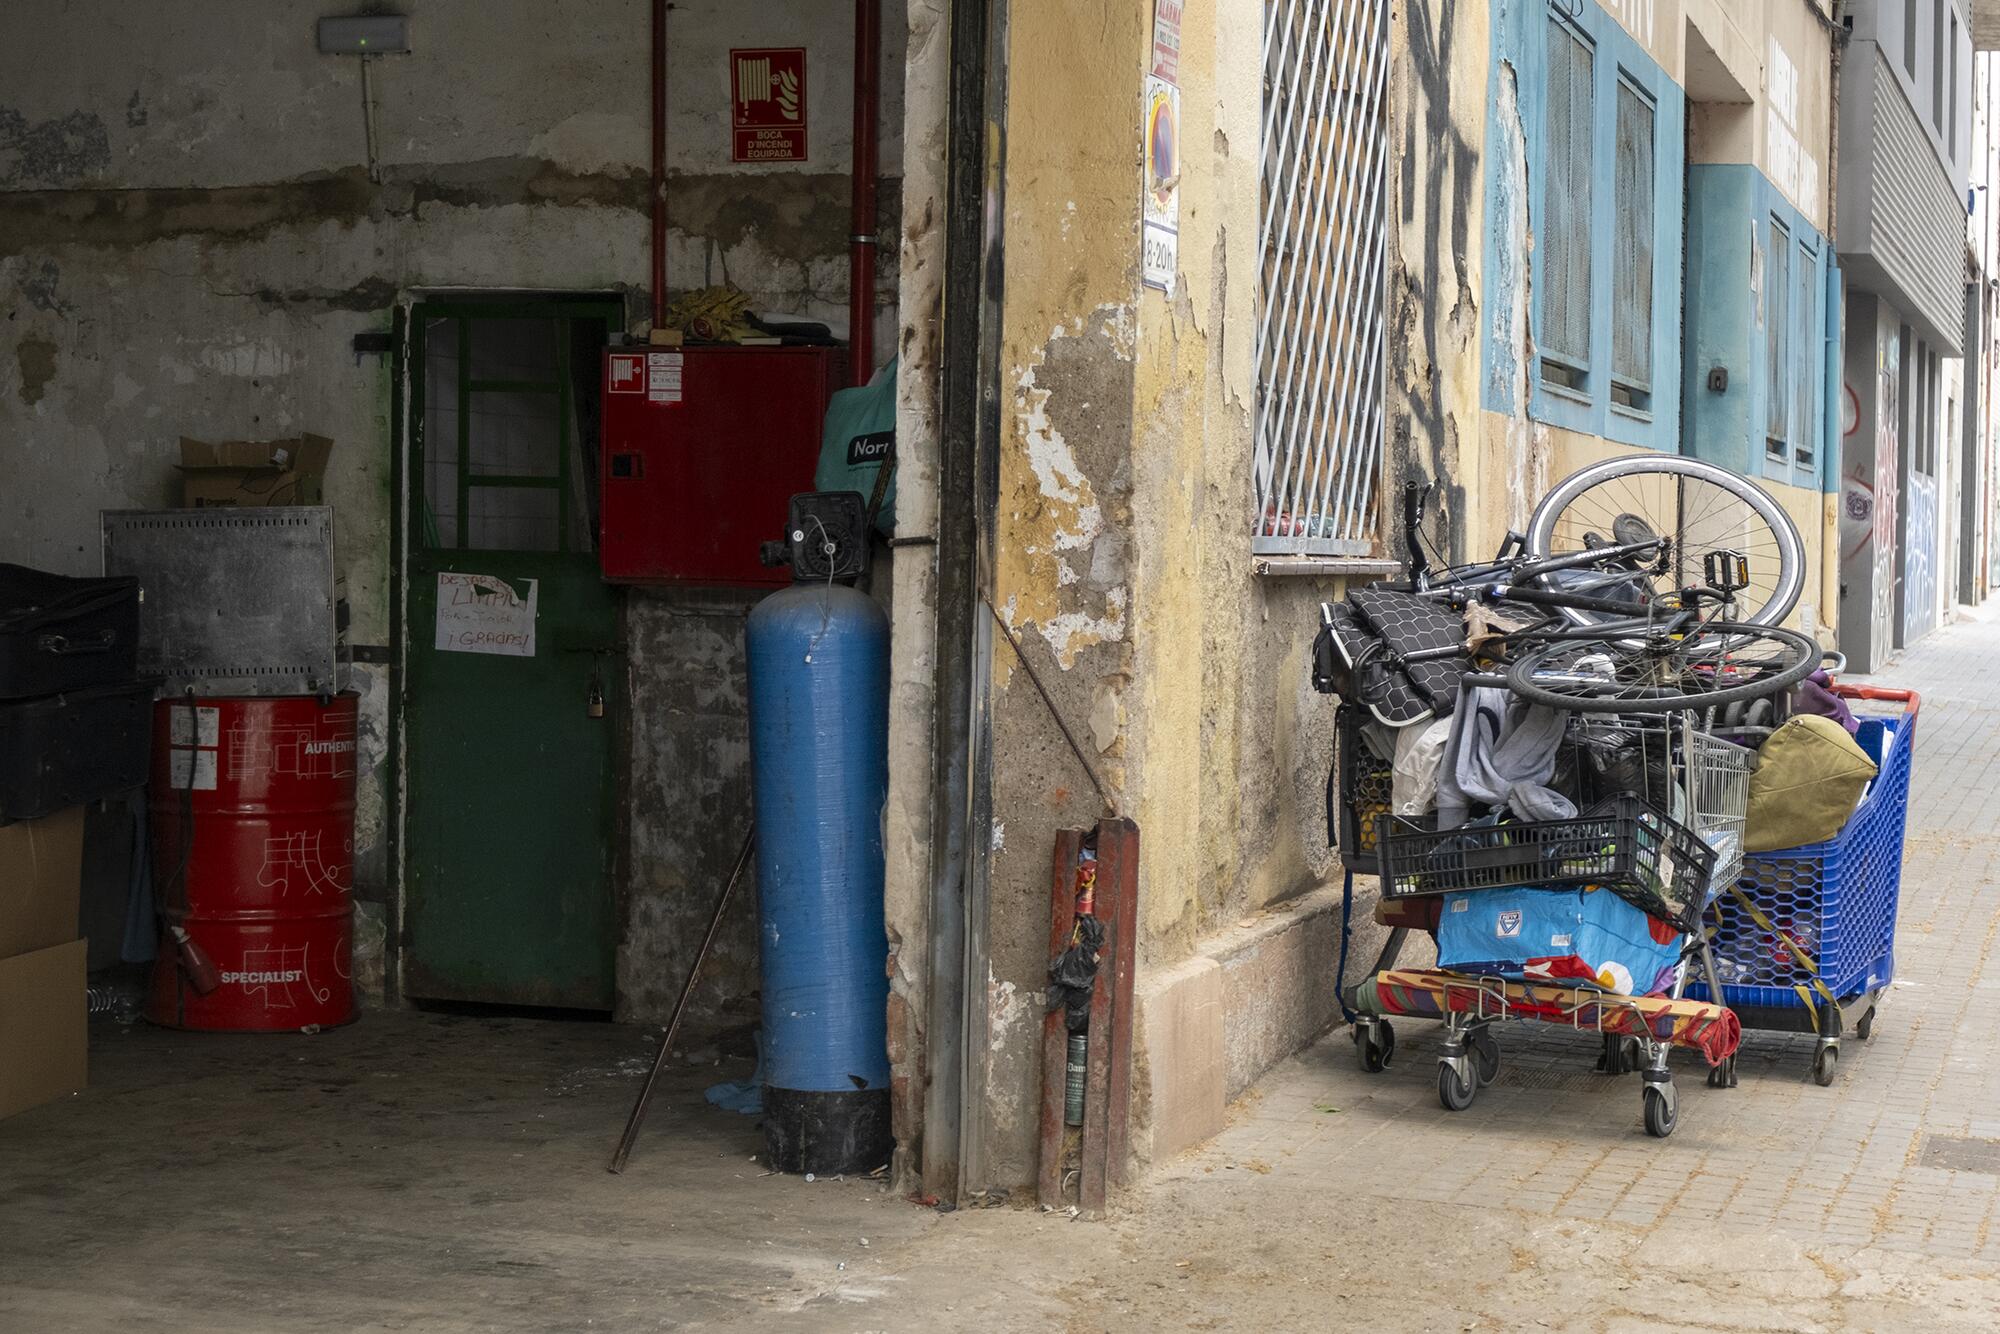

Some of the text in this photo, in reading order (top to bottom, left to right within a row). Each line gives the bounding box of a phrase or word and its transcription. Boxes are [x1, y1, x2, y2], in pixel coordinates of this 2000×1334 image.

[757, 131, 783, 140] BOCA
[748, 149, 792, 158] EQUIPADA
[222, 970, 302, 983] SPECIALIST
